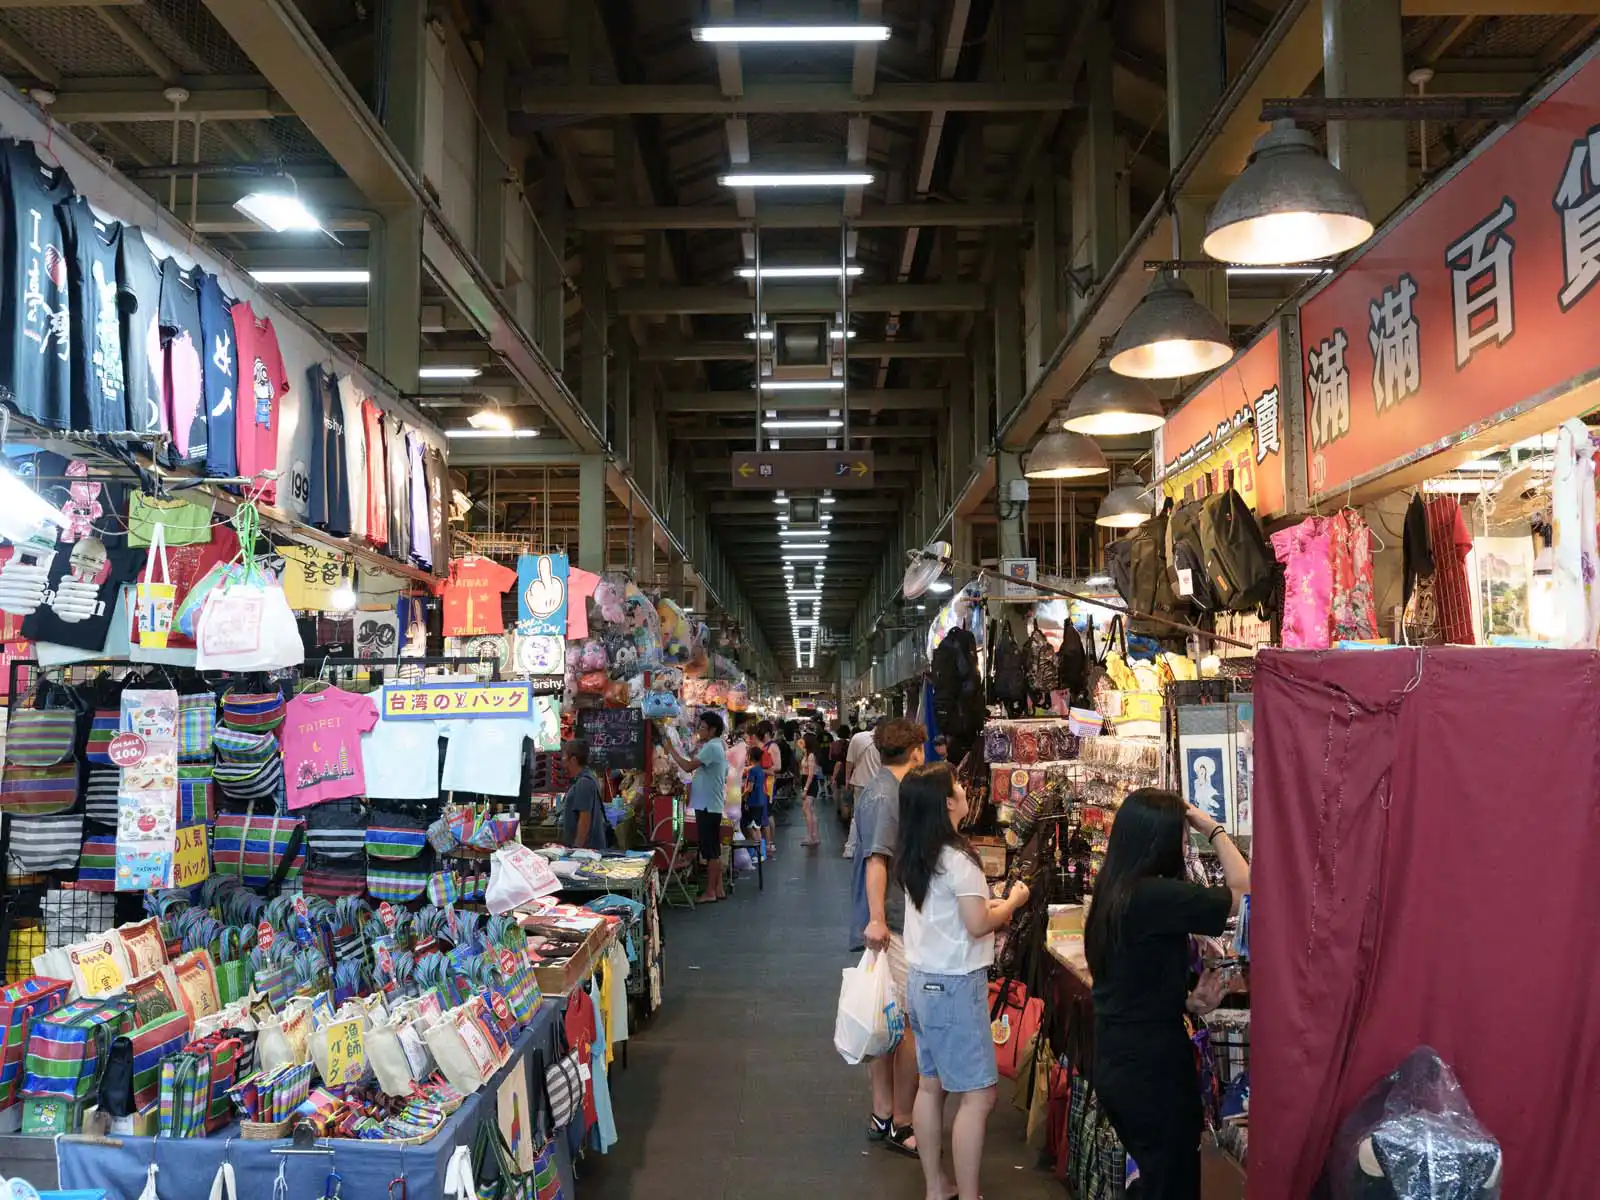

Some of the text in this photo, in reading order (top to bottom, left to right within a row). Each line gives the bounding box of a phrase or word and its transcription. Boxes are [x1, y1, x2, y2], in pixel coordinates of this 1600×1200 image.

[297, 716, 343, 735] TAIPEI
[123, 739, 139, 747] SALE
[344, 1022, 362, 1058] 漁師
[329, 1039, 342, 1083] バッグ
